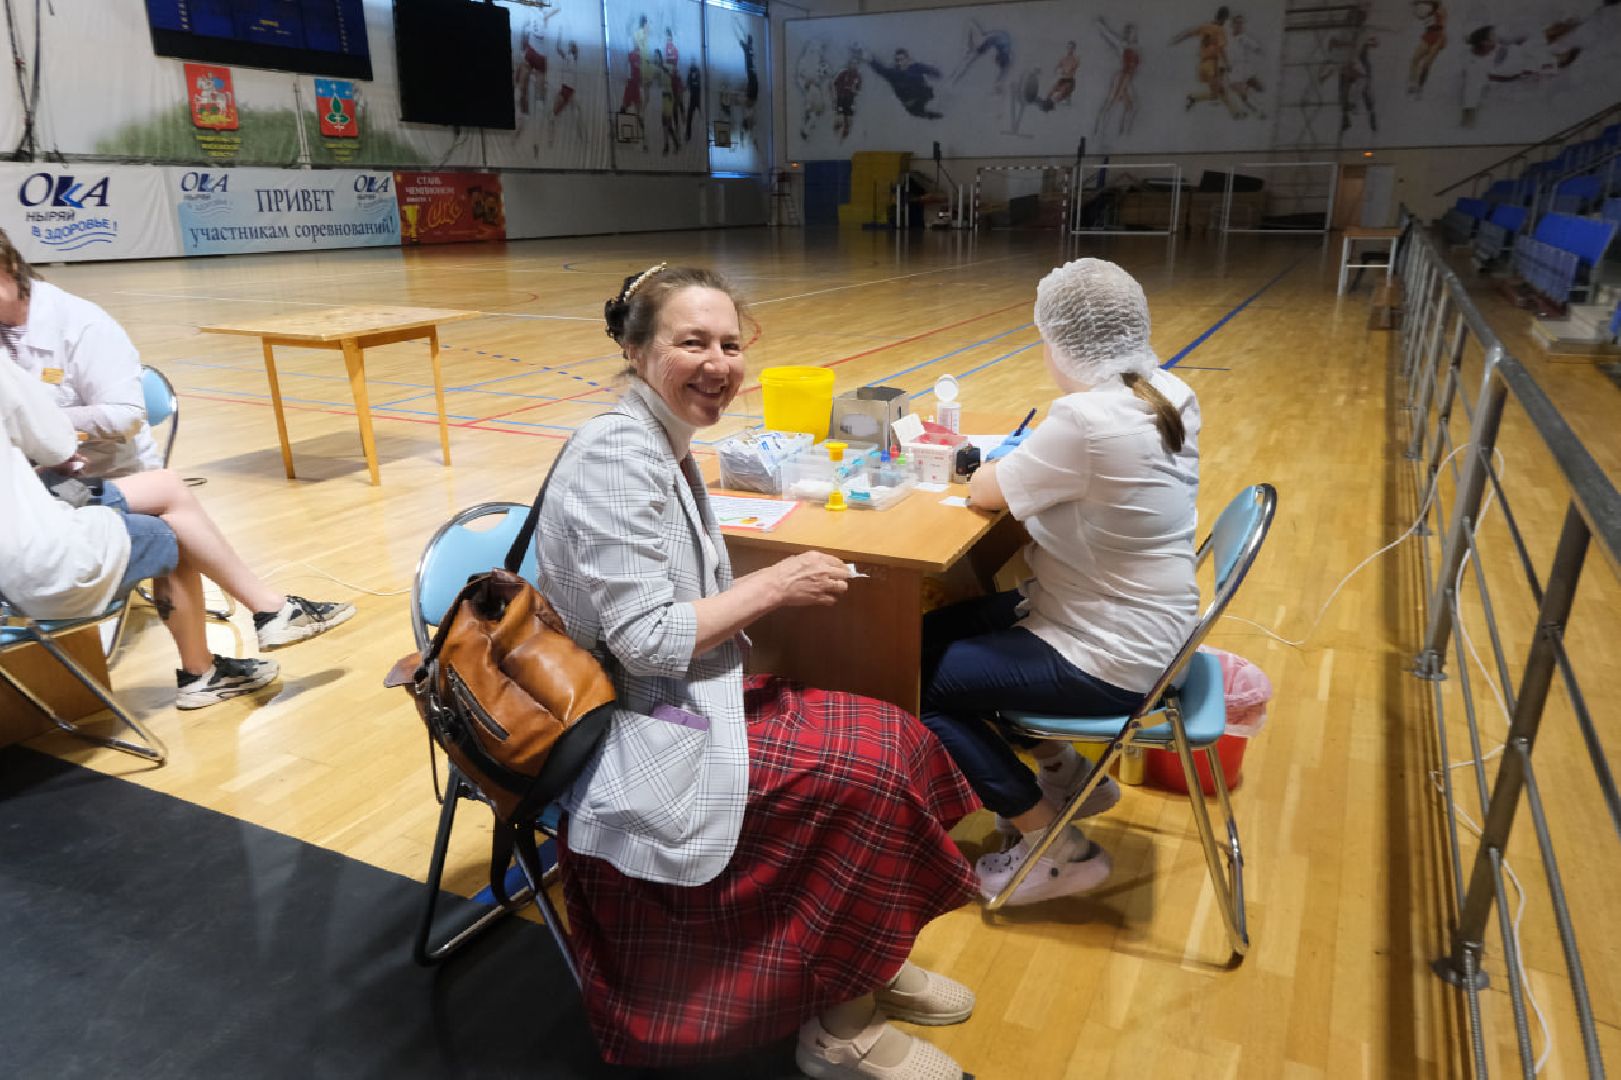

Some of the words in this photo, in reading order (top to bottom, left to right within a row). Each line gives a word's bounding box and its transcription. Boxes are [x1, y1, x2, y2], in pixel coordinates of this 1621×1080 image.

[18, 172, 110, 208] ОКА
[255, 187, 334, 212] ПРИВЕТ
[26, 209, 76, 222] НЫРЯЙ
[31, 225, 41, 237] В
[189, 224, 290, 249] участникам
[294, 215, 395, 244] соревнований!
